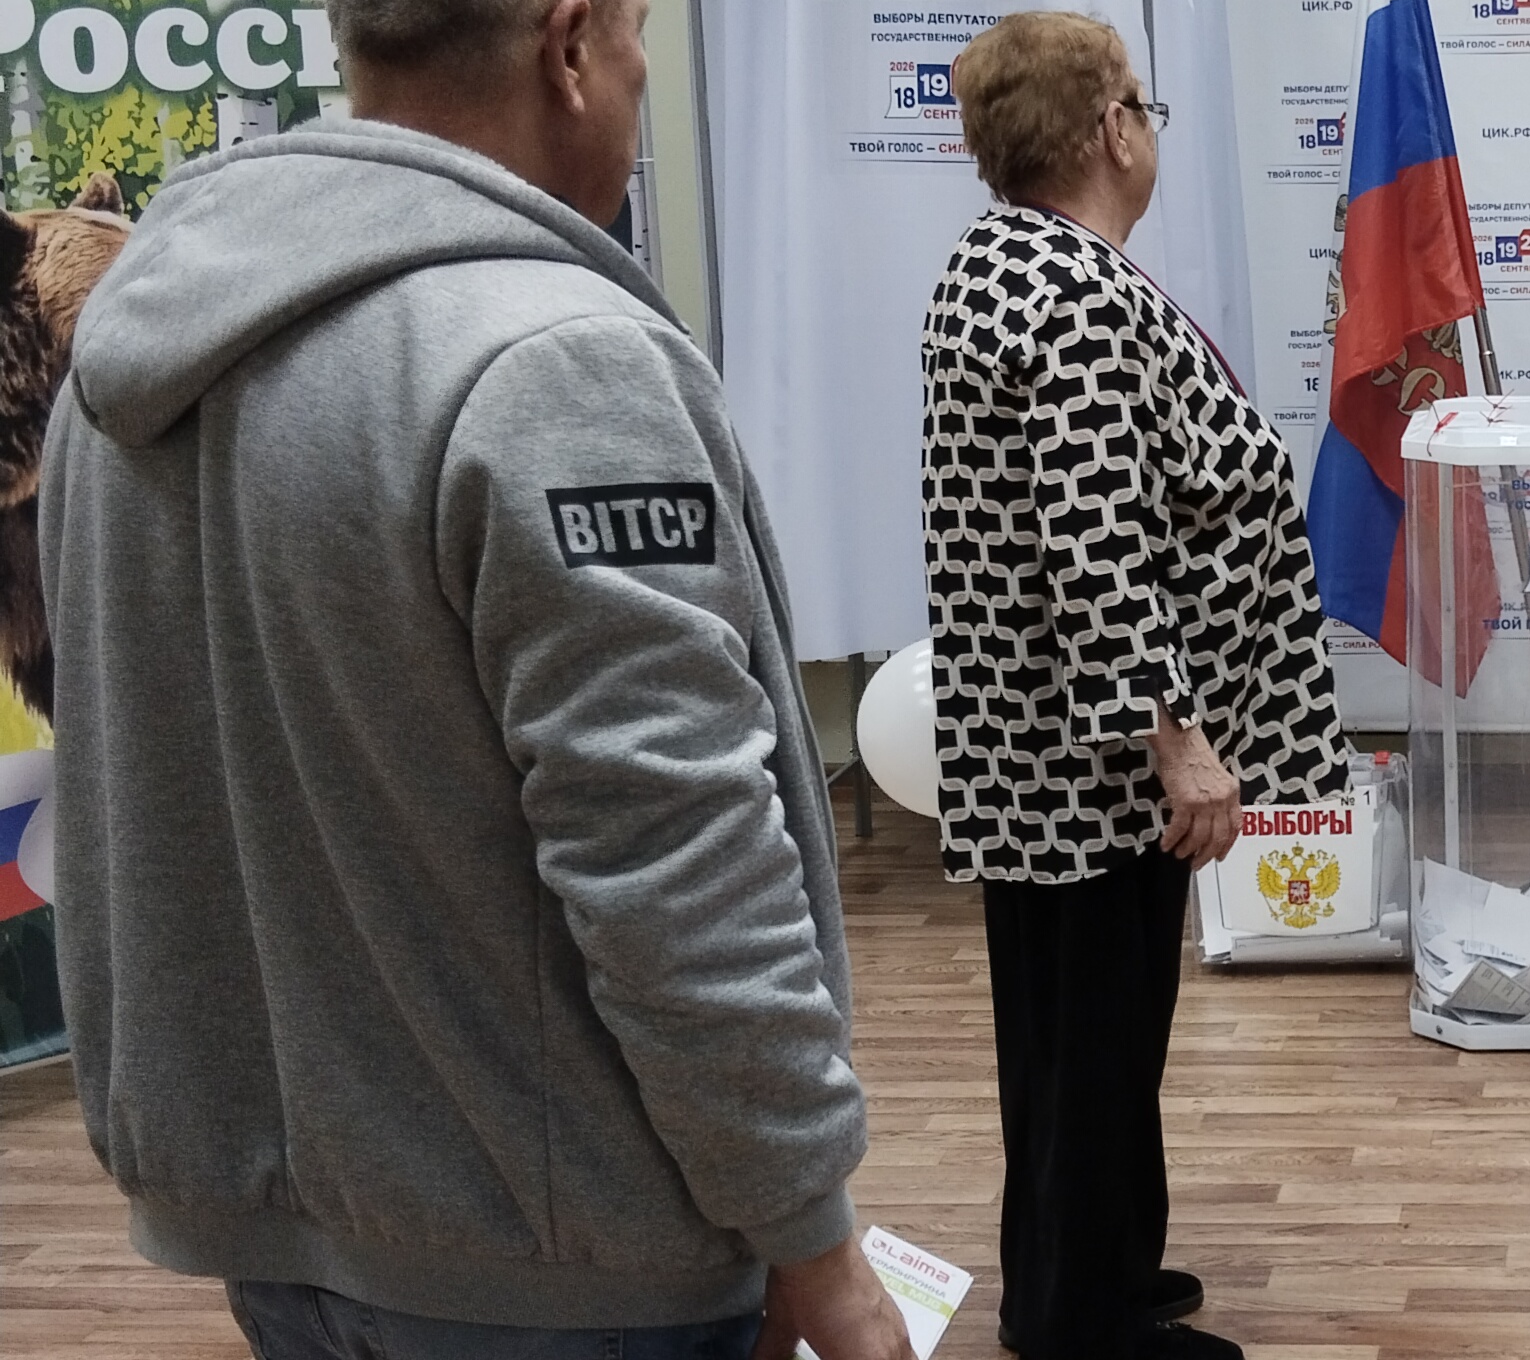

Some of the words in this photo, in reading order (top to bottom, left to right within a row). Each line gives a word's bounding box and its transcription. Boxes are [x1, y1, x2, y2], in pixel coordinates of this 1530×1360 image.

[1302, 1, 1353, 12] ЦИК.РФ
[1472, 4, 1490, 18] 18
[874, 13, 924, 23] ВЫБОРЫ
[1440, 40, 1464, 48] ТВОЙ
[890, 62, 914, 71] 2026
[895, 88, 915, 108] 18
[920, 74, 948, 96] 19
[1299, 135, 1316, 149] 18
[1320, 125, 1338, 141] 19
[850, 141, 884, 152] ТВОЙ
[888, 143, 923, 152] ГОЛОС
[939, 143, 974, 153] СИЛ
[1267, 170, 1291, 178] ТВОЙ
[1477, 252, 1493, 265] 18
[1498, 242, 1516, 257] 19
[1274, 412, 1297, 420] ТВОЙ
[1483, 616, 1523, 630] ТВОЙ
[1341, 796, 1355, 806] №
[1363, 791, 1370, 805] 1
[1242, 810, 1352, 836] ВЫБОРЫ
[886, 1246, 950, 1284] Laima
